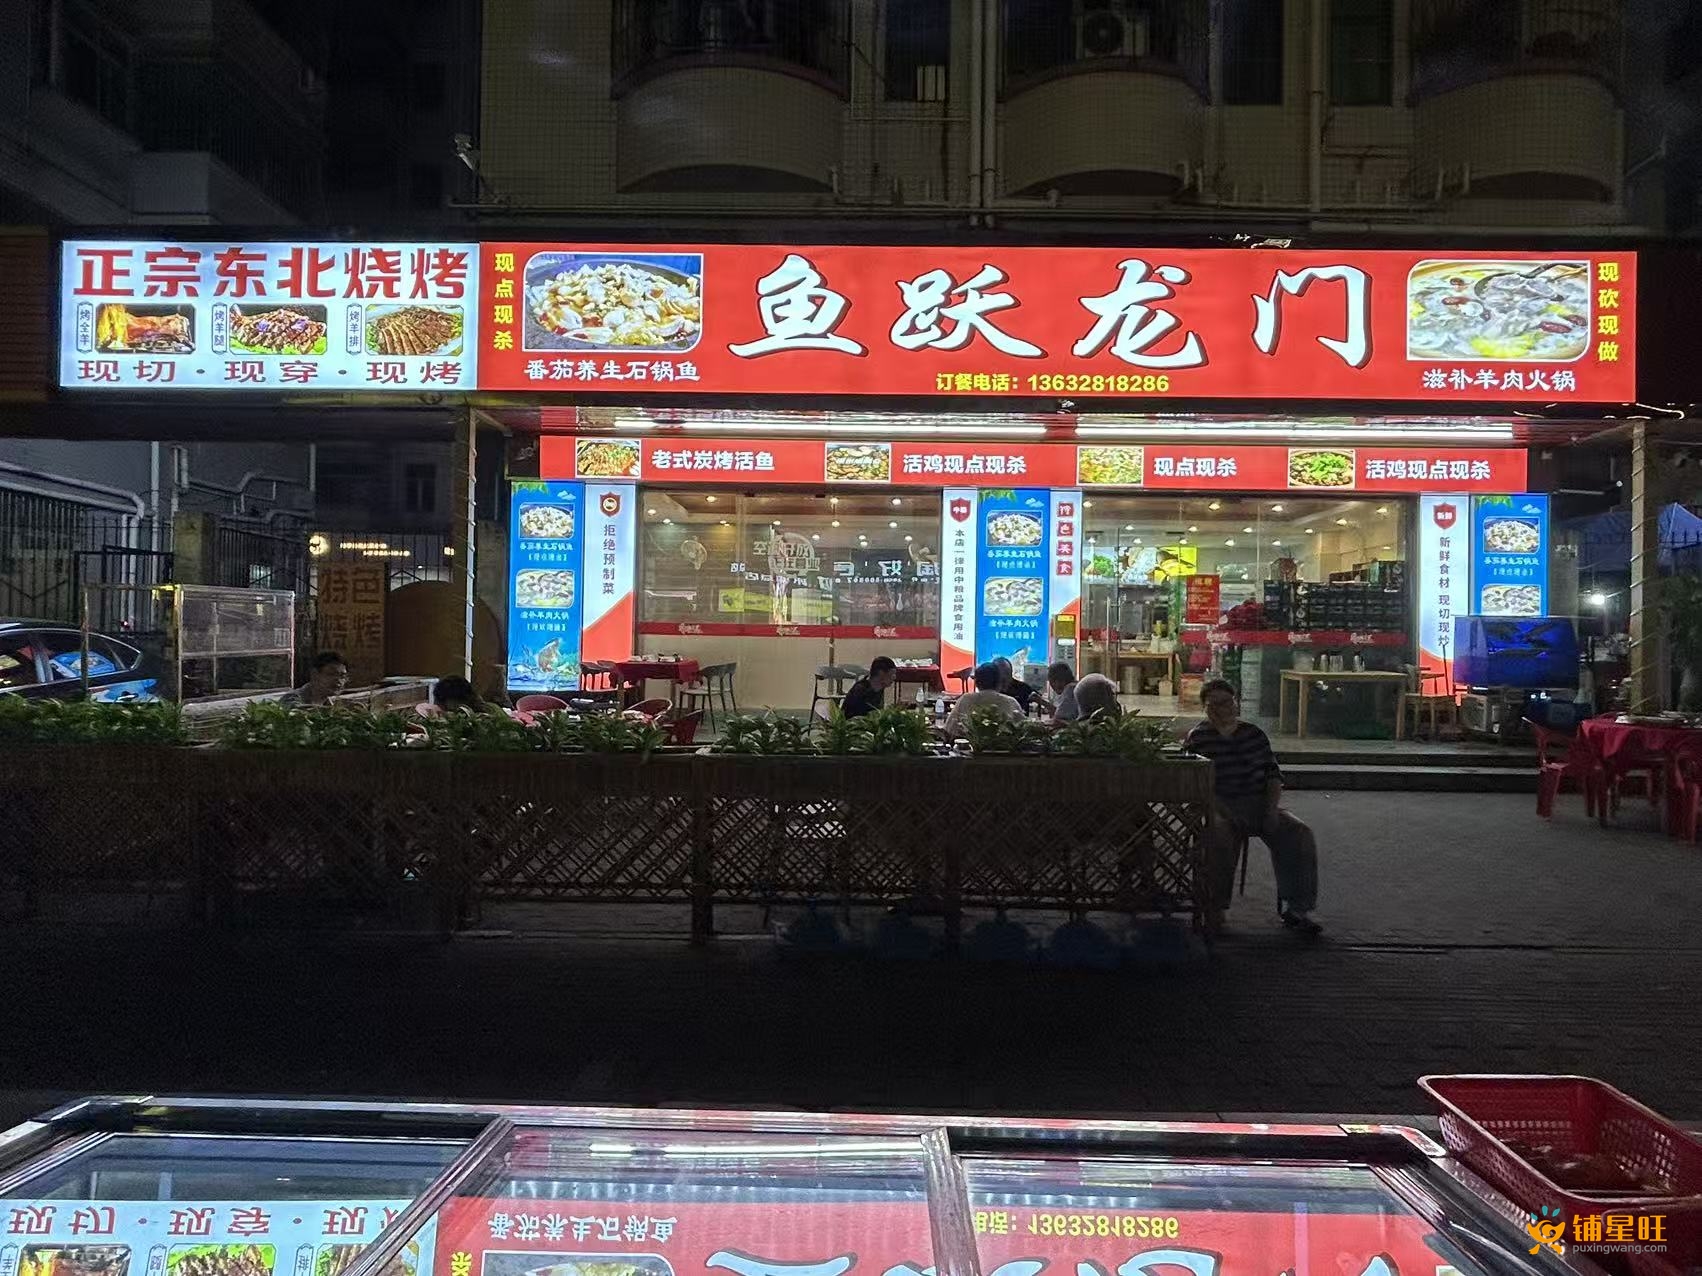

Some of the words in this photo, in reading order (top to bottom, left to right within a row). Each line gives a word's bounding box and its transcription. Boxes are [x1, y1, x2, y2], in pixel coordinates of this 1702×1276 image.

[73, 247, 468, 298] 正宗东北烧烤
[494, 252, 515, 351] 现点现杀
[727, 253, 1373, 369] 鱼跃龙门
[1597, 262, 1620, 362] 现砍现做
[79, 309, 90, 345] 烤全羊
[214, 310, 225, 346] 烤羊腿
[349, 310, 360, 347] 烤羊排
[523, 359, 700, 382] 番茄养生石锅鱼
[1423, 369, 1576, 392] 滋补羊肉火锅
[652, 450, 775, 471] 老式炭烤活鱼
[902, 454, 1027, 475] 活鸡现点现杀
[1153, 456, 1237, 478] 现点现杀
[1365, 459, 1491, 480] 活鸡现点现杀
[602, 524, 616, 595] 拒绝预制菜
[1439, 537, 1450, 588] 新鲜食材
